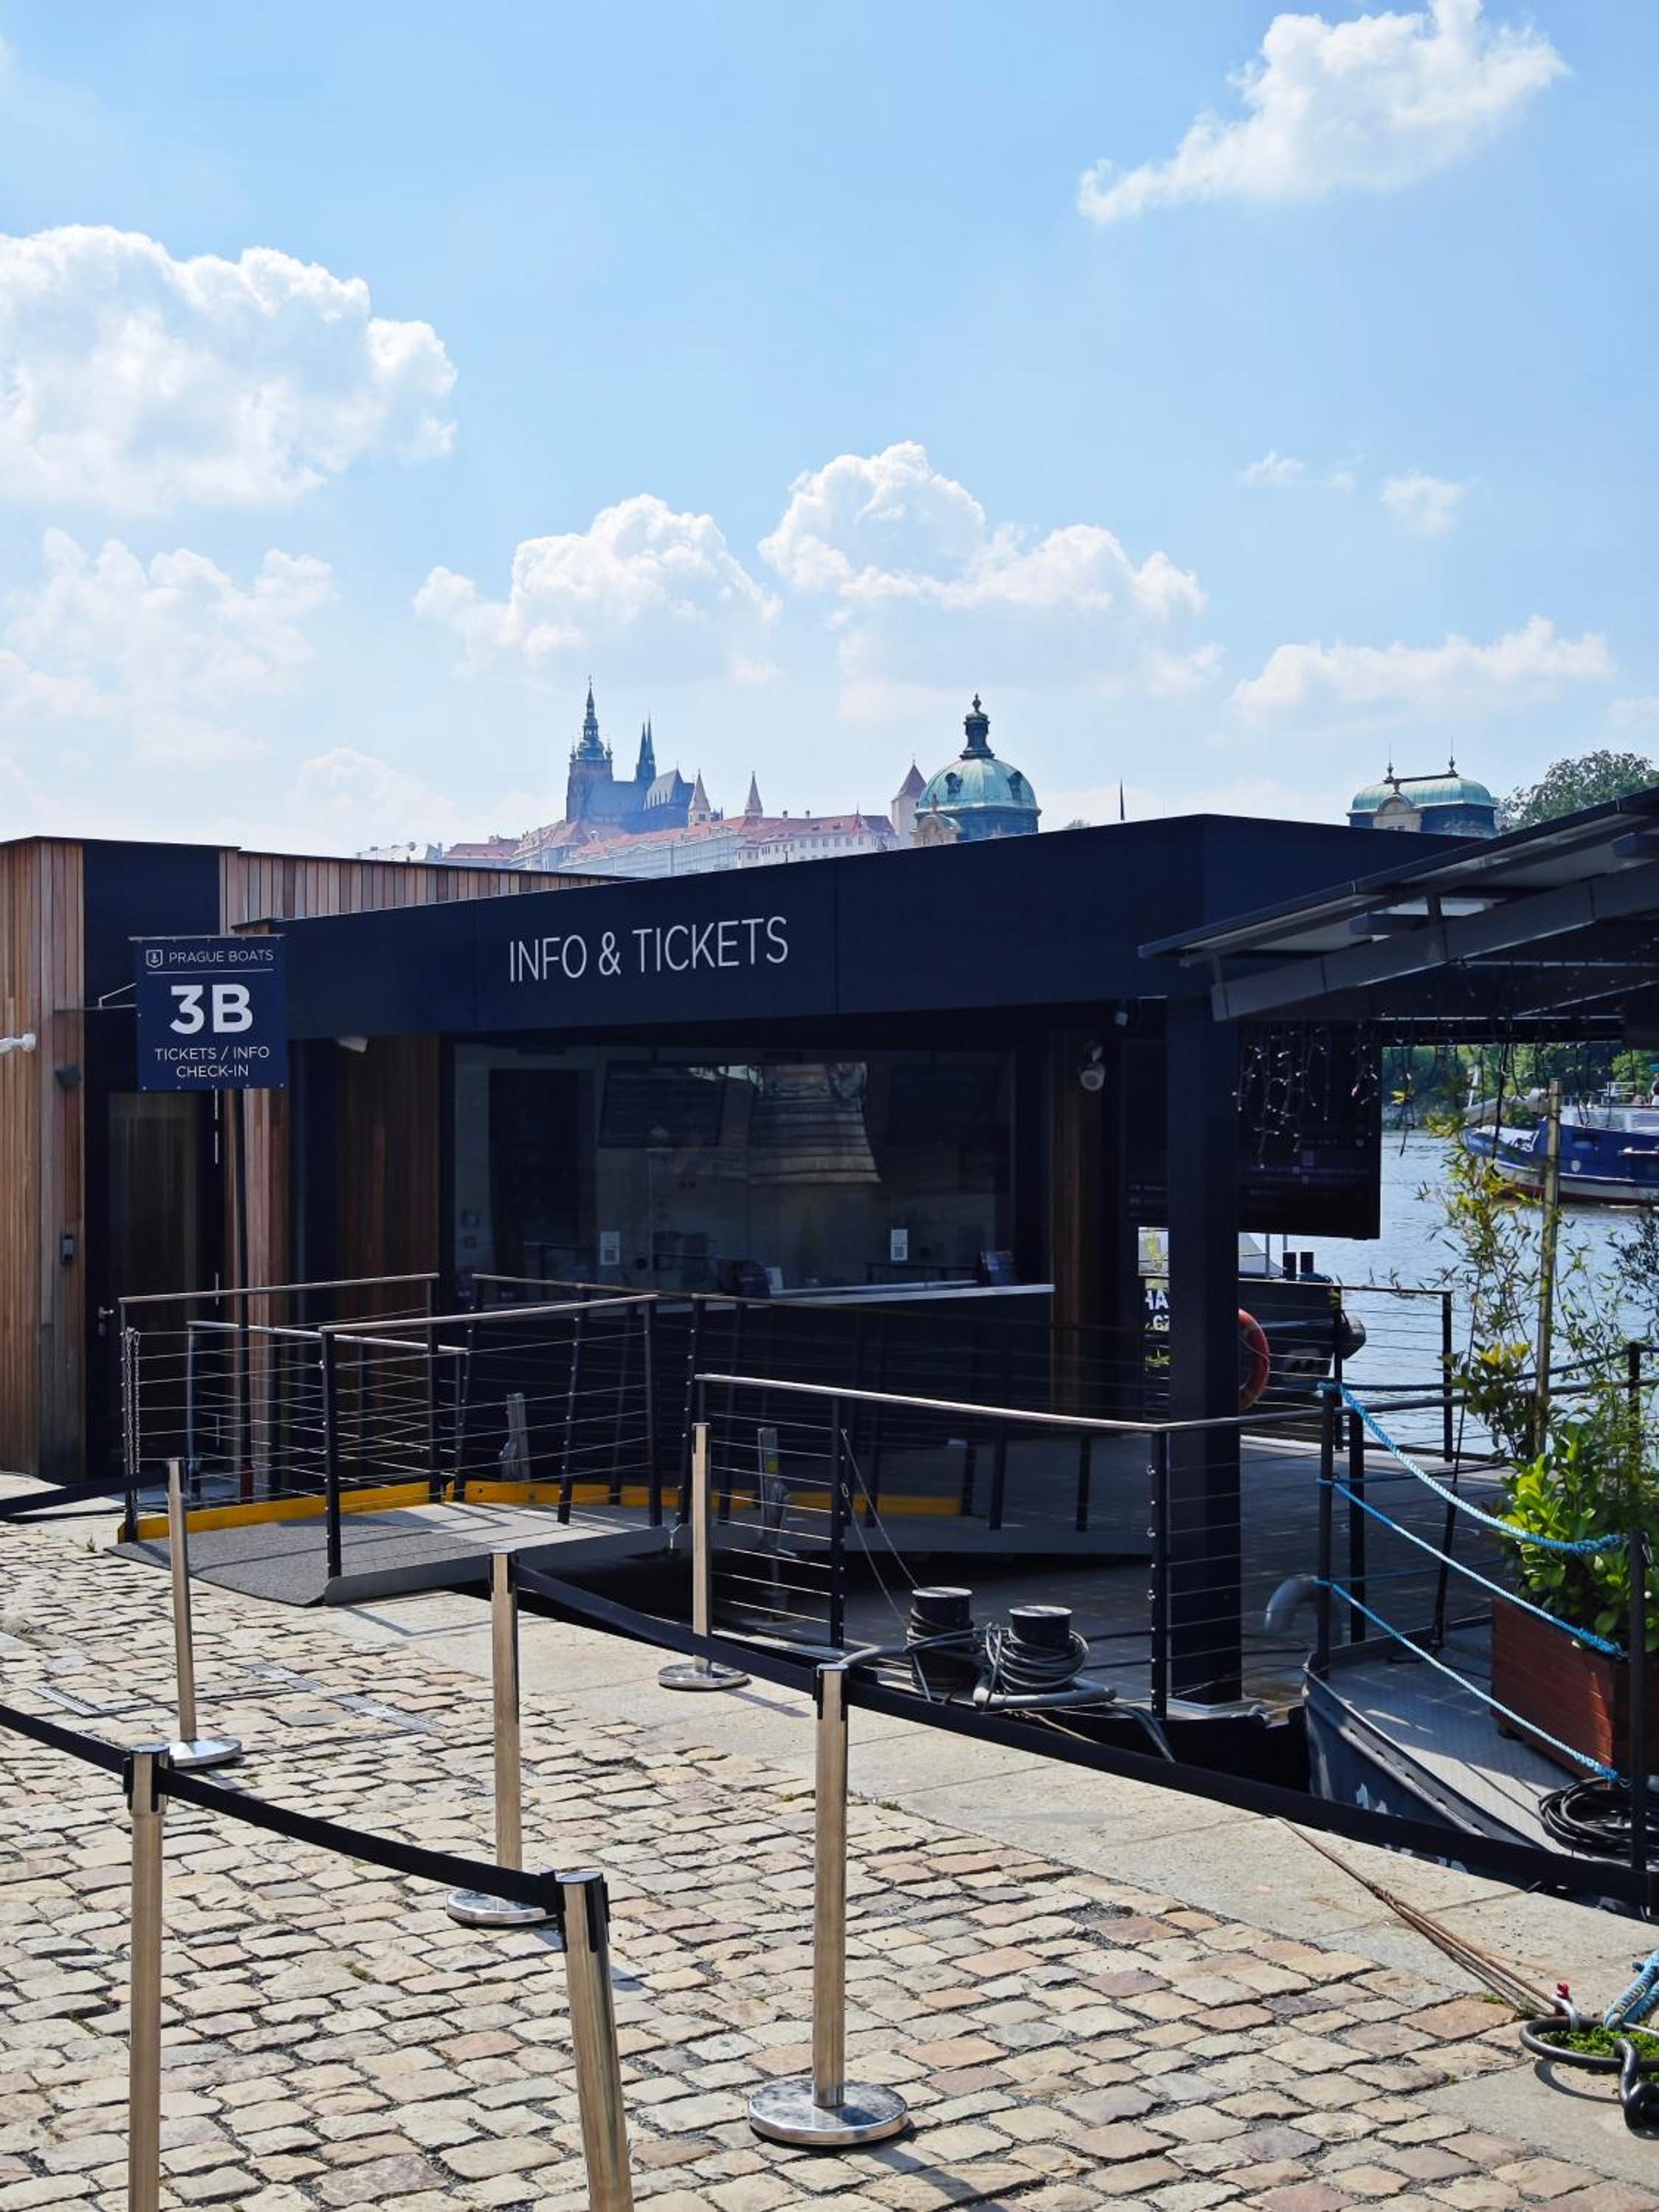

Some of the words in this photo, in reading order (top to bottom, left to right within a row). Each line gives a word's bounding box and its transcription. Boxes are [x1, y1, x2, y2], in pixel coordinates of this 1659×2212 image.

[168, 950, 225, 964] PRAGUE
[228, 949, 274, 962] BOATS
[509, 933, 588, 983] INFO
[597, 931, 622, 976] &
[631, 915, 789, 973] TICKETS
[169, 983, 254, 1035] 3B
[154, 1047, 218, 1061] TICKETS
[220, 1045, 230, 1062] /
[233, 1046, 271, 1059] INFO
[175, 1064, 249, 1079] CHECK-IN
